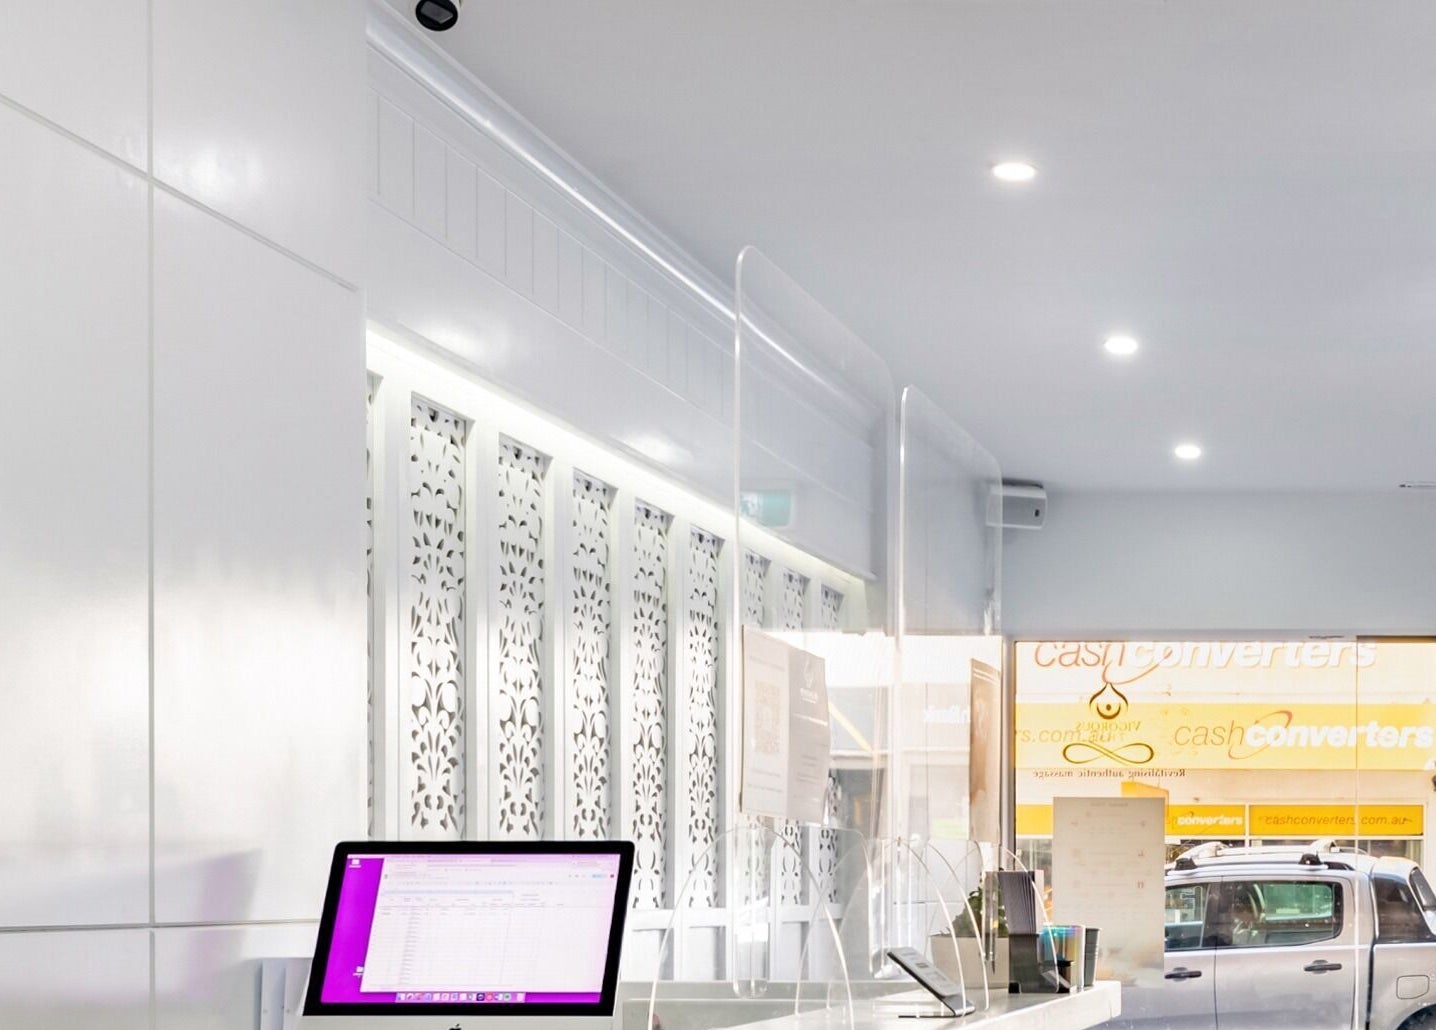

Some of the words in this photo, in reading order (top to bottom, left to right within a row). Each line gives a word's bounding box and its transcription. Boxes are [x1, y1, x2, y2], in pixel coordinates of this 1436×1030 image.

[1034, 642, 1125, 667] cash
[1130, 642, 1375, 669] converters
[1174, 720, 1245, 746] cash
[1245, 720, 1435, 747] converters
